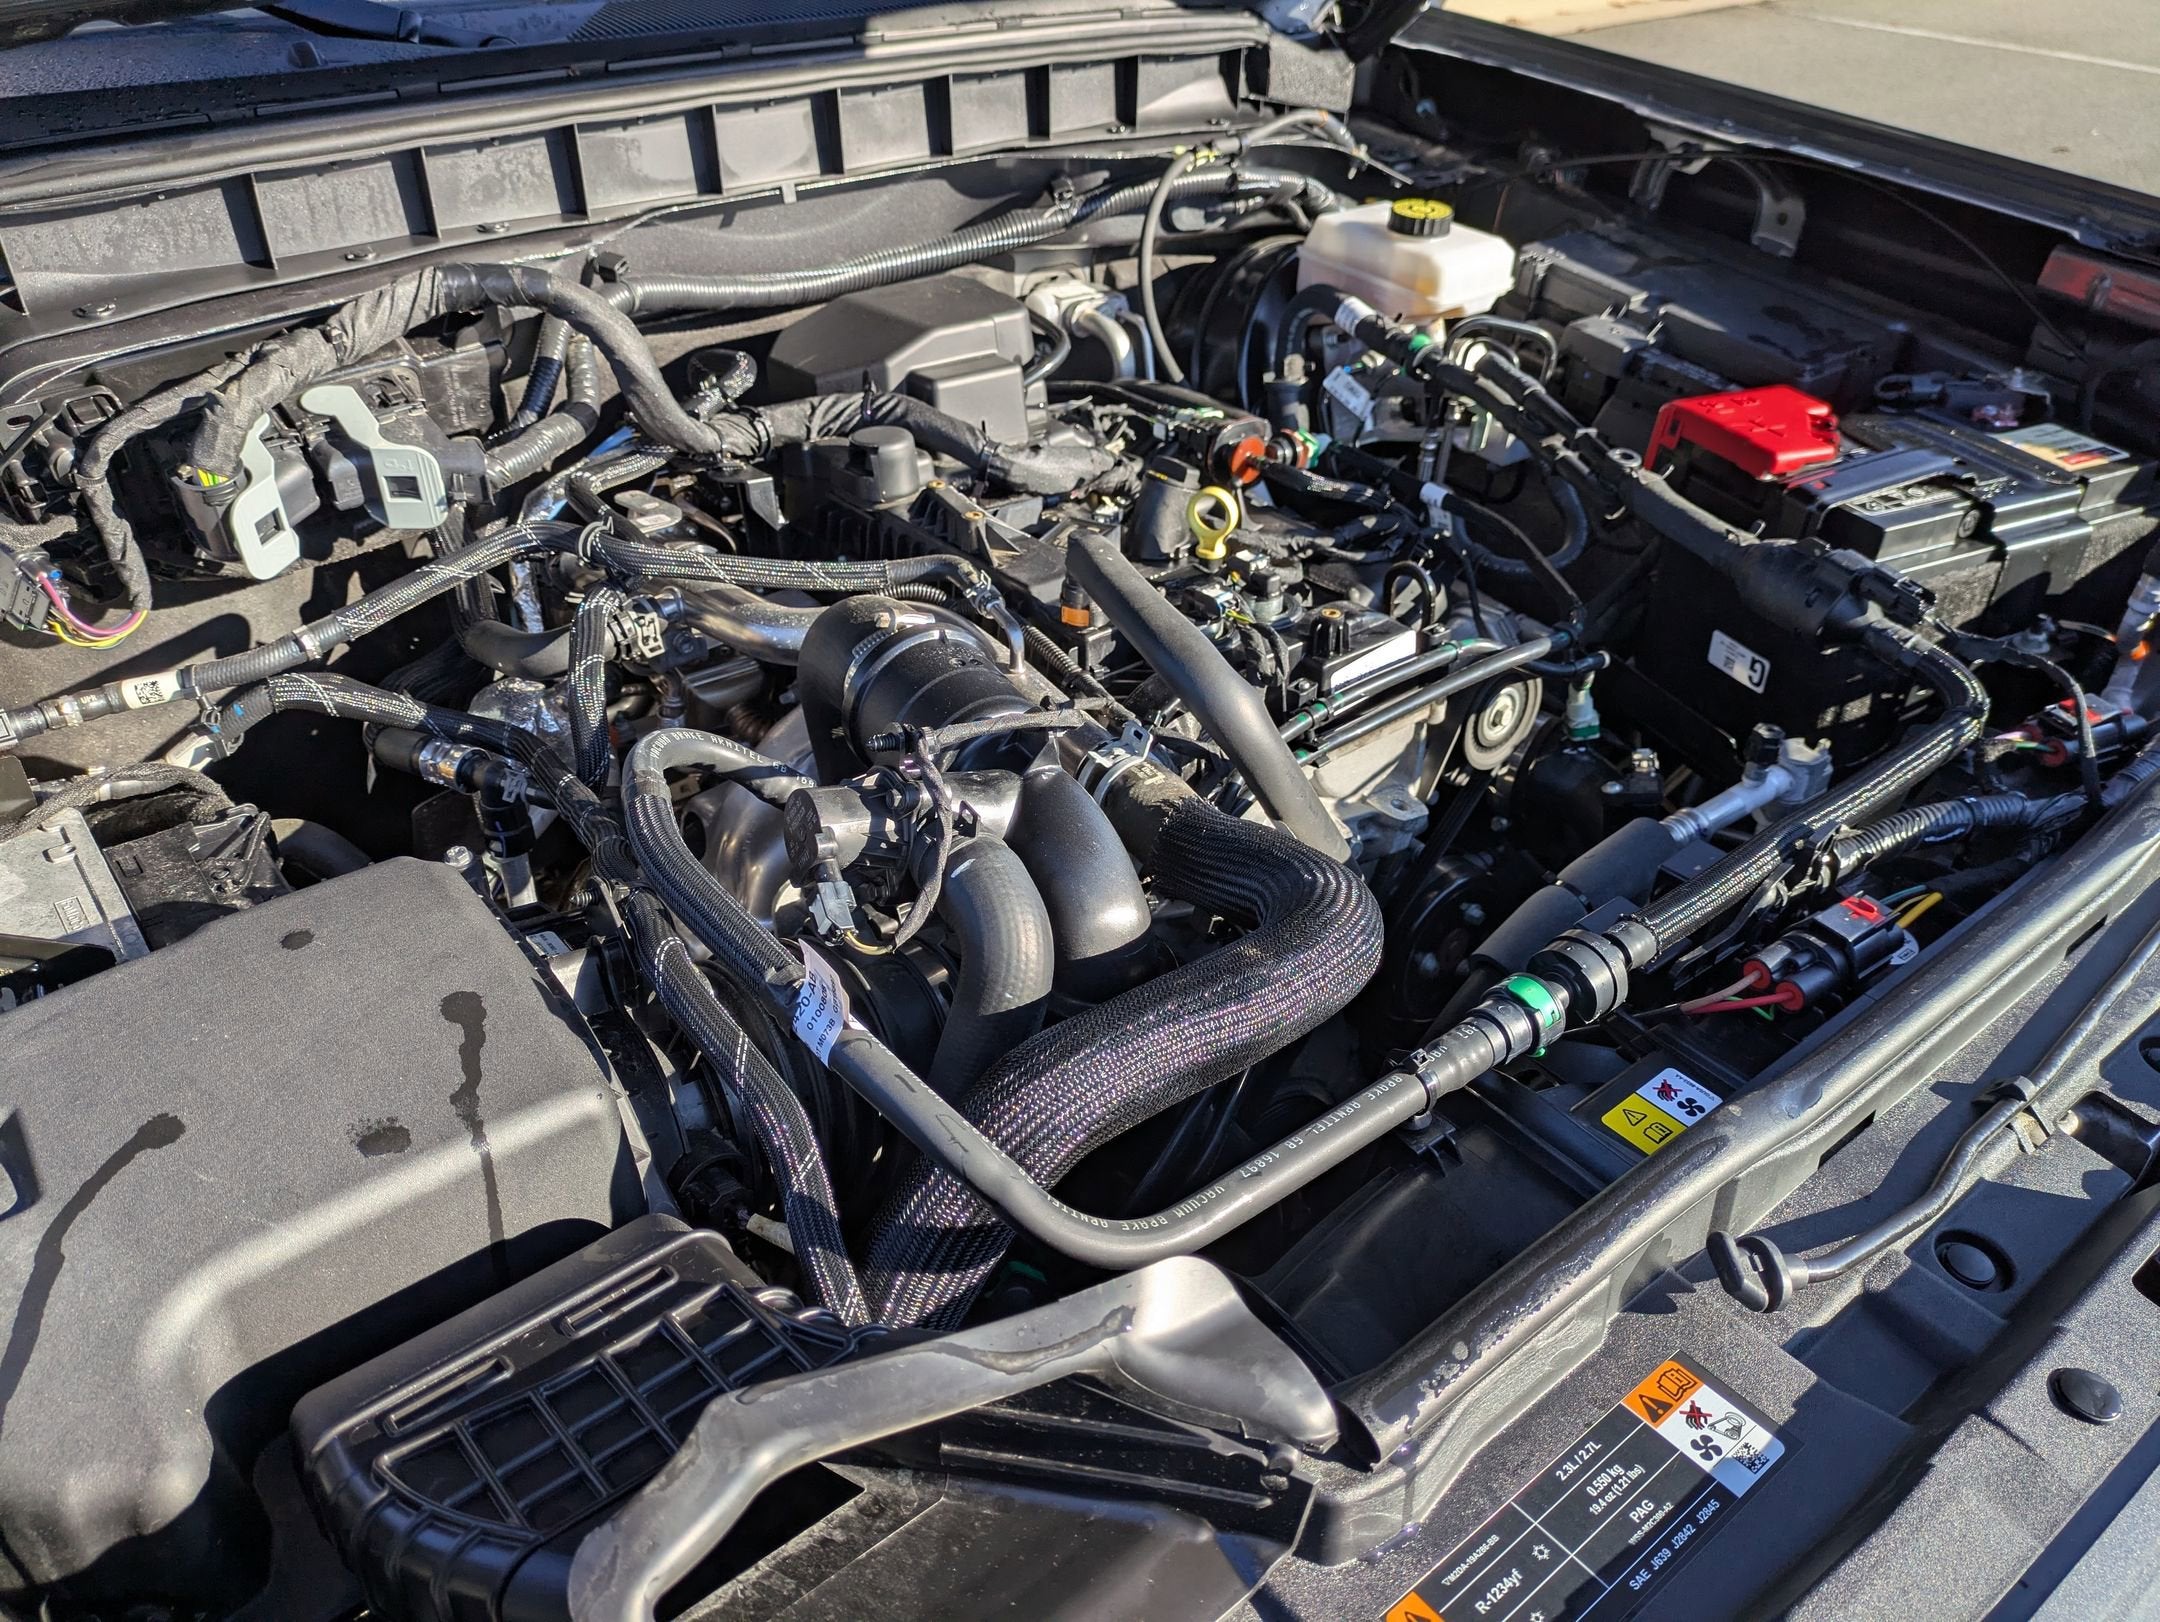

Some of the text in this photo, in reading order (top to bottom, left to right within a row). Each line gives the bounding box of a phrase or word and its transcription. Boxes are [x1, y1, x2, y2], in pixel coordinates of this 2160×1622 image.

[1748, 656, 1766, 688] G
[670, 731, 705, 742] BRAKE
[793, 970, 816, 1033] 420-AB
[1367, 1074, 1403, 1101] BRAKE
[1121, 1214, 1169, 1231] BRAKE
[1555, 1461, 1580, 1481] 2.3L
[1578, 1441, 1602, 1460] 2.7L
[1586, 1464, 1625, 1496] 0.550 kg
[1589, 1463, 1646, 1515] 19.4 oz (1.21 lbs)
[1629, 1499, 1655, 1523] PAG
[1629, 1498, 1721, 1591] SAE J639 J2842 J2845
[1474, 1567, 1523, 1615] R-1234yf
